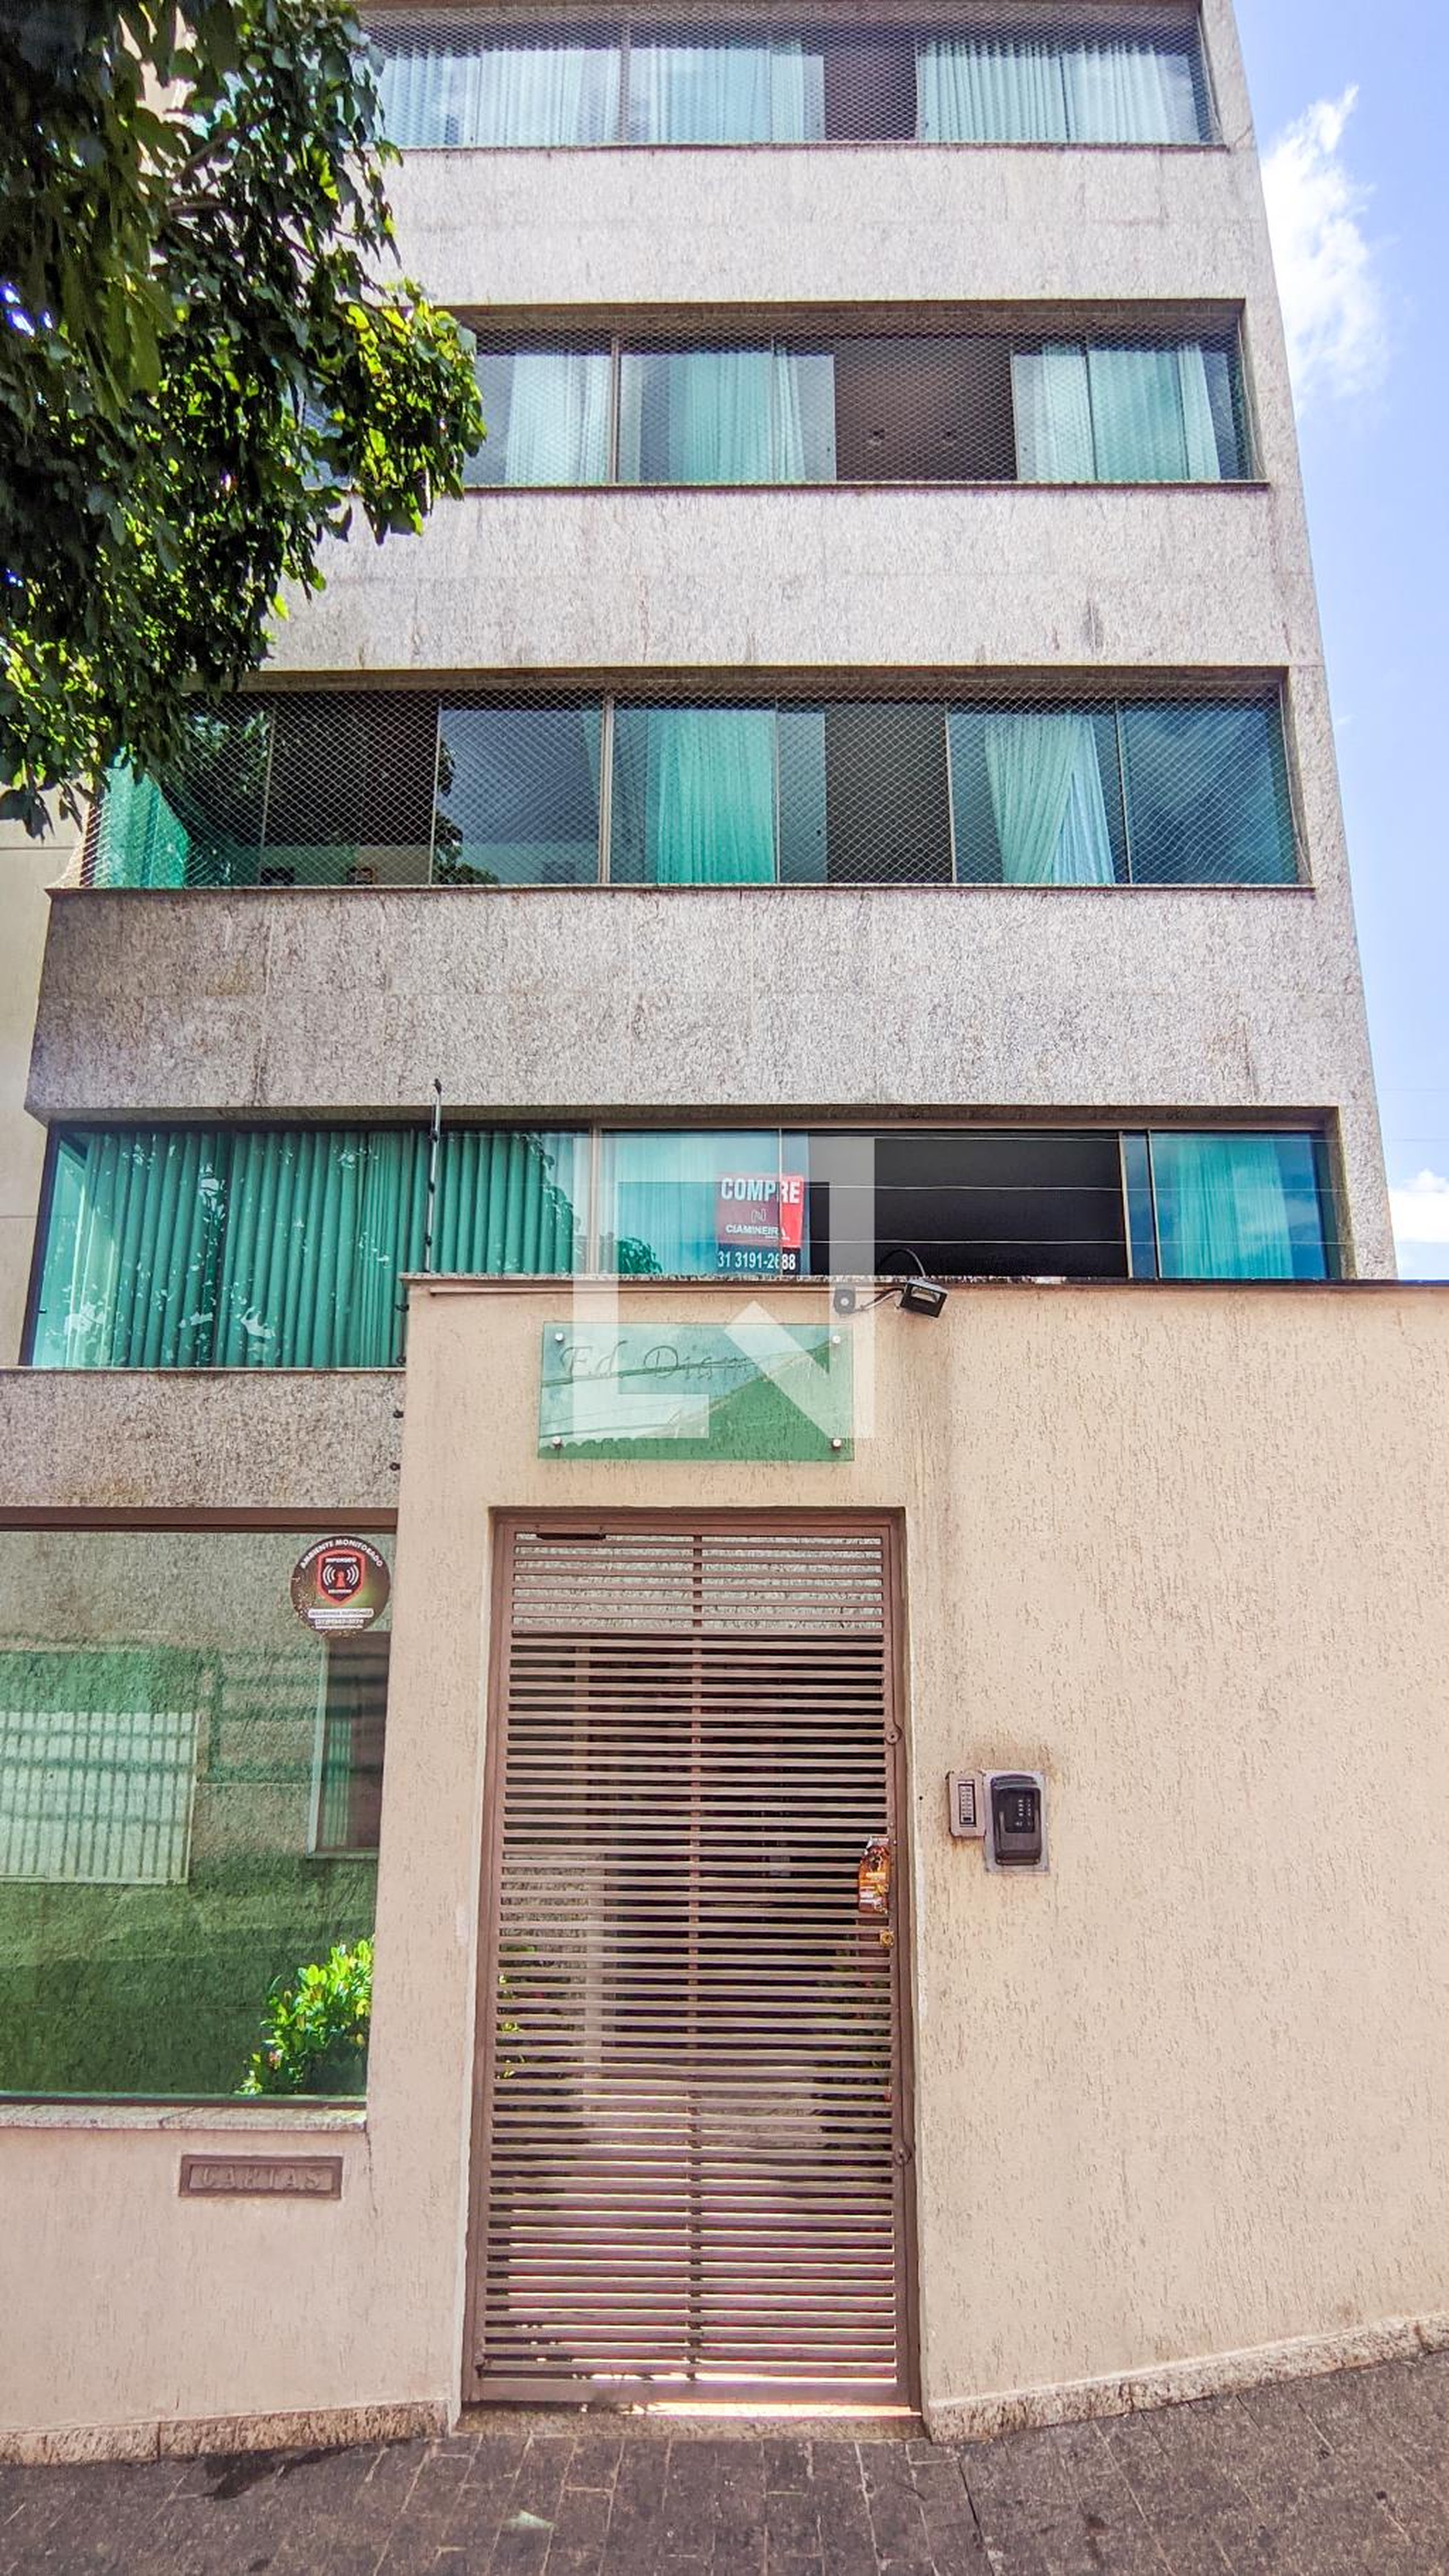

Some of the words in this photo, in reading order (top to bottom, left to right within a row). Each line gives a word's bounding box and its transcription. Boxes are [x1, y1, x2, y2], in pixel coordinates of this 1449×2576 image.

[721, 1177, 800, 1204] COMPRE
[718, 1250, 731, 1267] 31
[300, 1540, 334, 1568] AMBIENTE
[335, 1539, 383, 1567] MONITORADO
[203, 2166, 321, 2190] CARTAS
